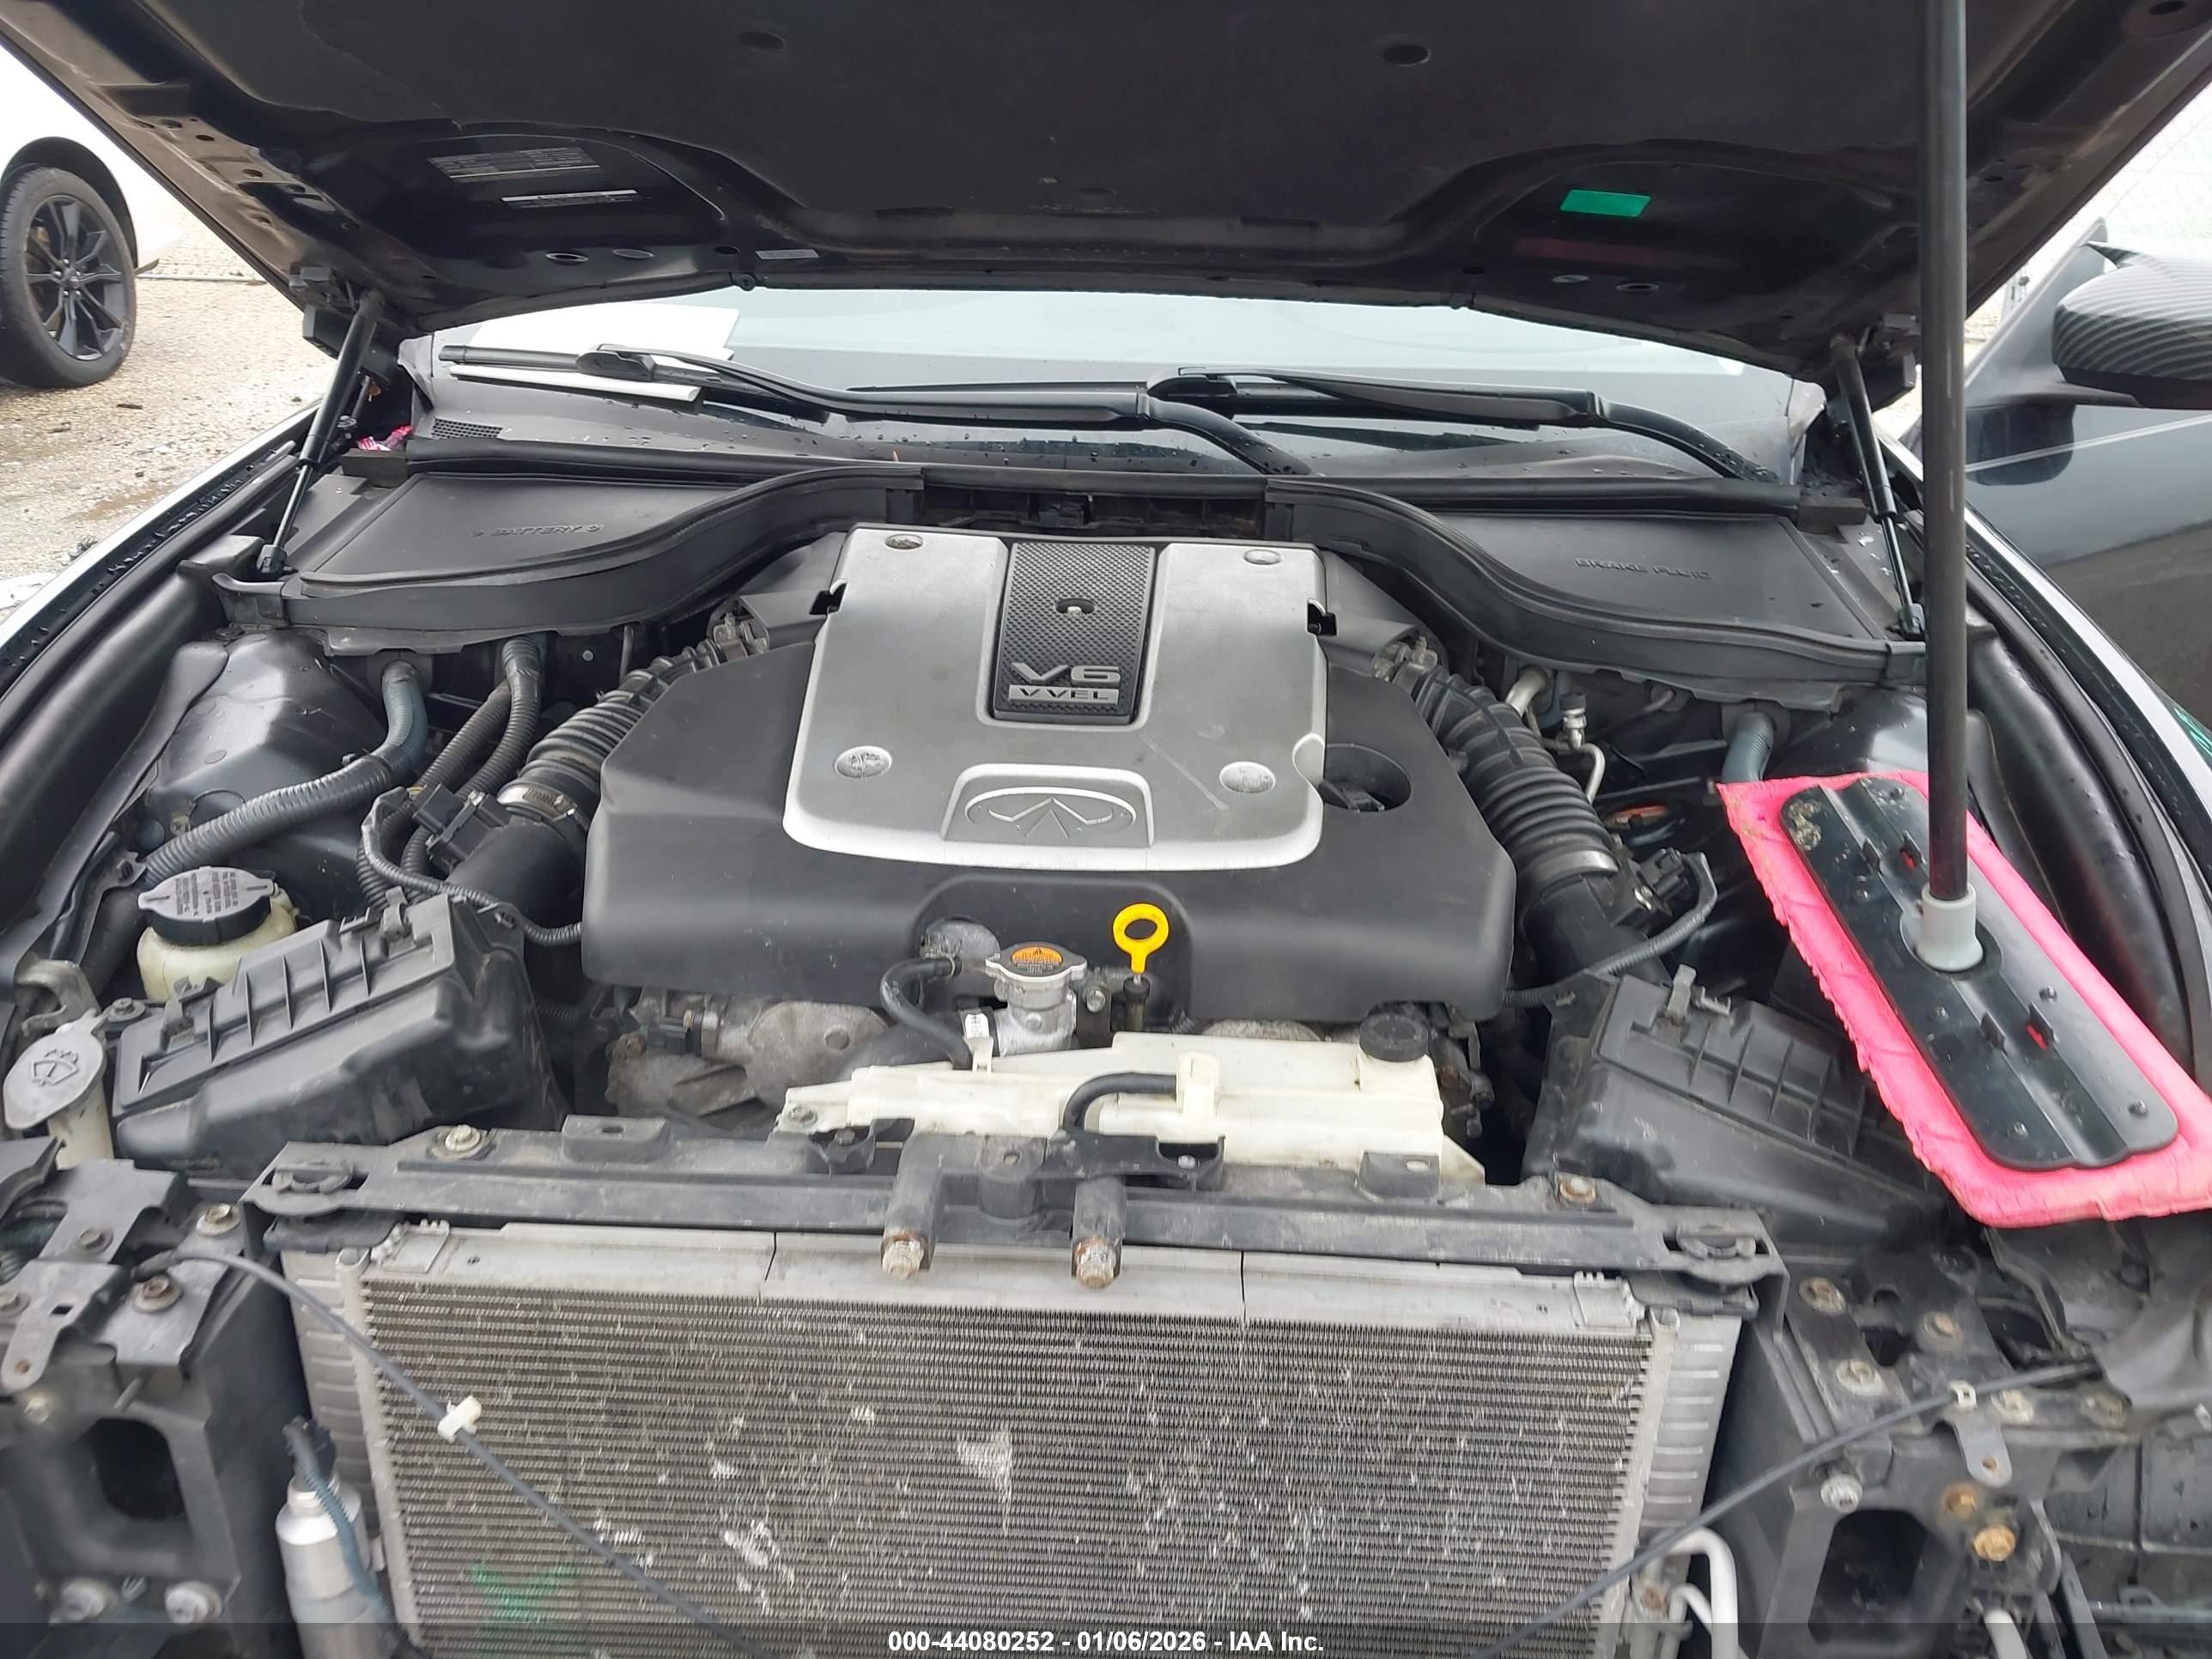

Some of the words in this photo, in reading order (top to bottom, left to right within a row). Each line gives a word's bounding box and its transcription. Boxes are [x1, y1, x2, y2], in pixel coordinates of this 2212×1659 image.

[491, 525, 583, 537] BATTERY
[1574, 556, 1649, 574] BRAKE
[1651, 564, 1711, 580] FLUID
[1010, 661, 1121, 688] V6
[1018, 688, 1109, 701] VVEL
